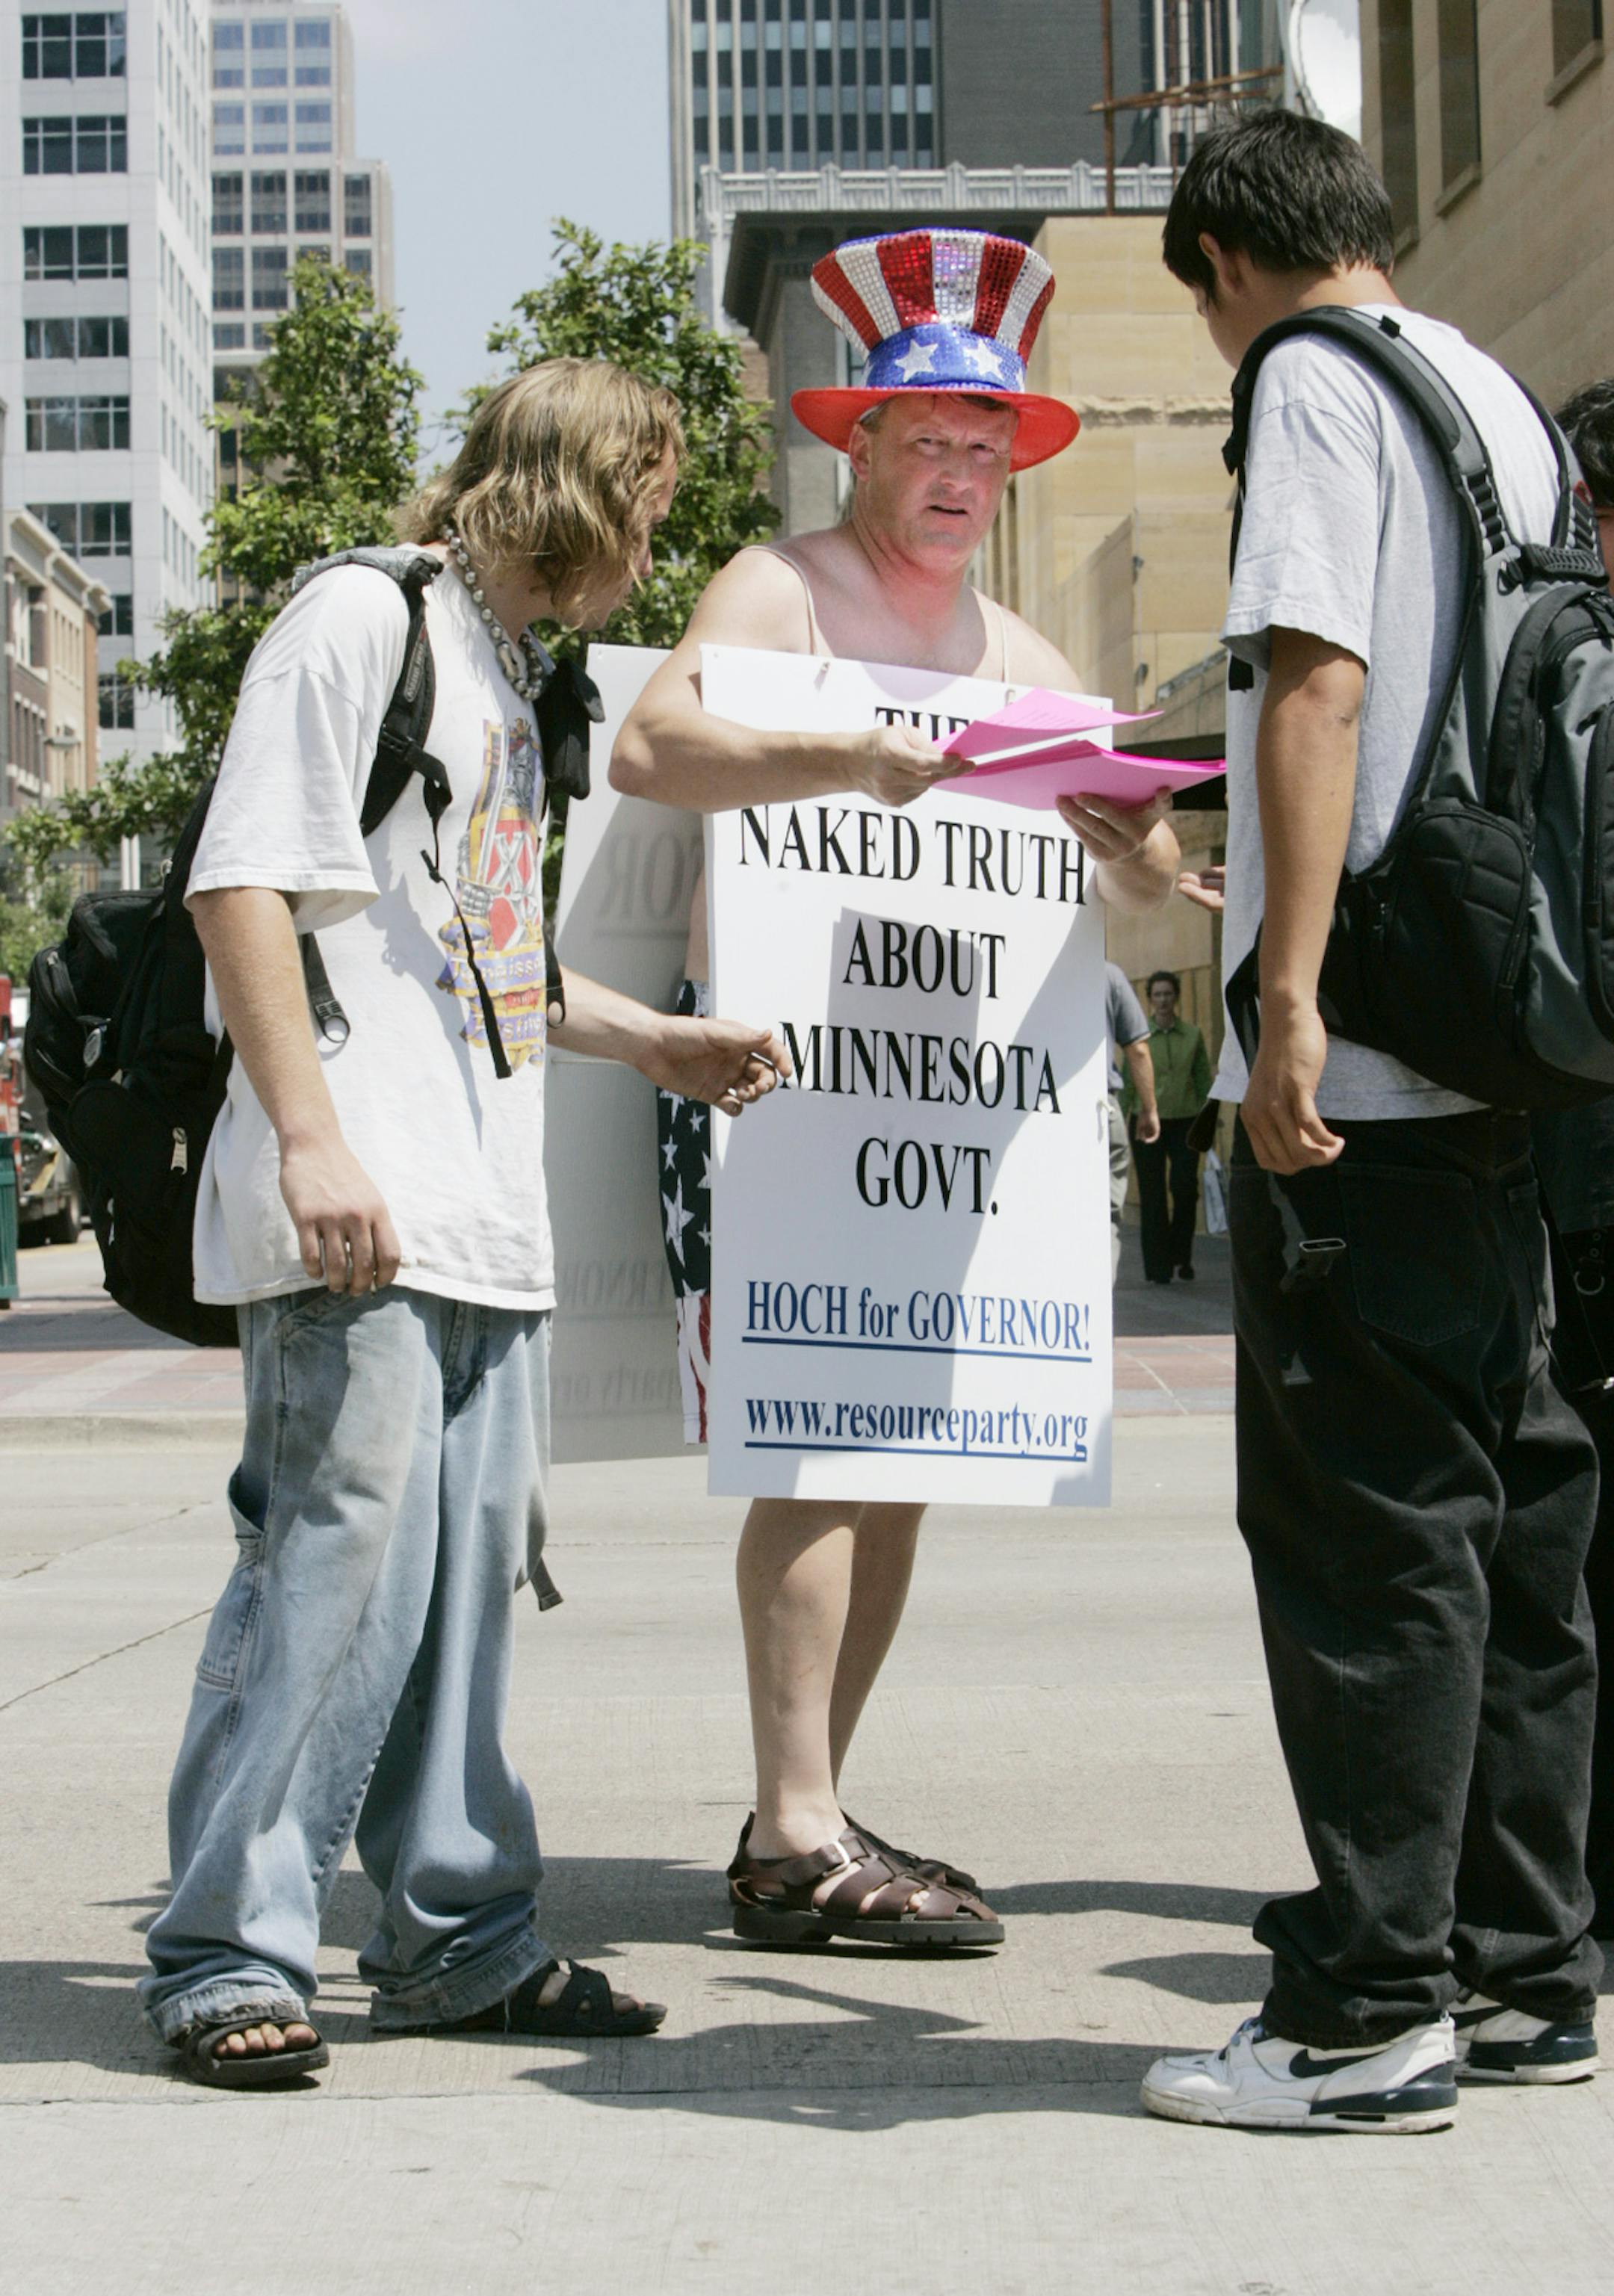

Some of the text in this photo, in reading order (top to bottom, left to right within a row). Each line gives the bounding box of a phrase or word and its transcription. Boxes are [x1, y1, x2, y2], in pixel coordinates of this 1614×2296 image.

[739, 805, 1086, 906] NAKED TRUTH
[842, 918, 1006, 999] ABOUT
[779, 1022, 1062, 1114] MINNESOTA
[856, 1137, 998, 1216] GOVT.
[746, 1281, 1090, 1351] HOCH for GOVERNOR!
[746, 1399, 1088, 1458] www.resourceparty.org
